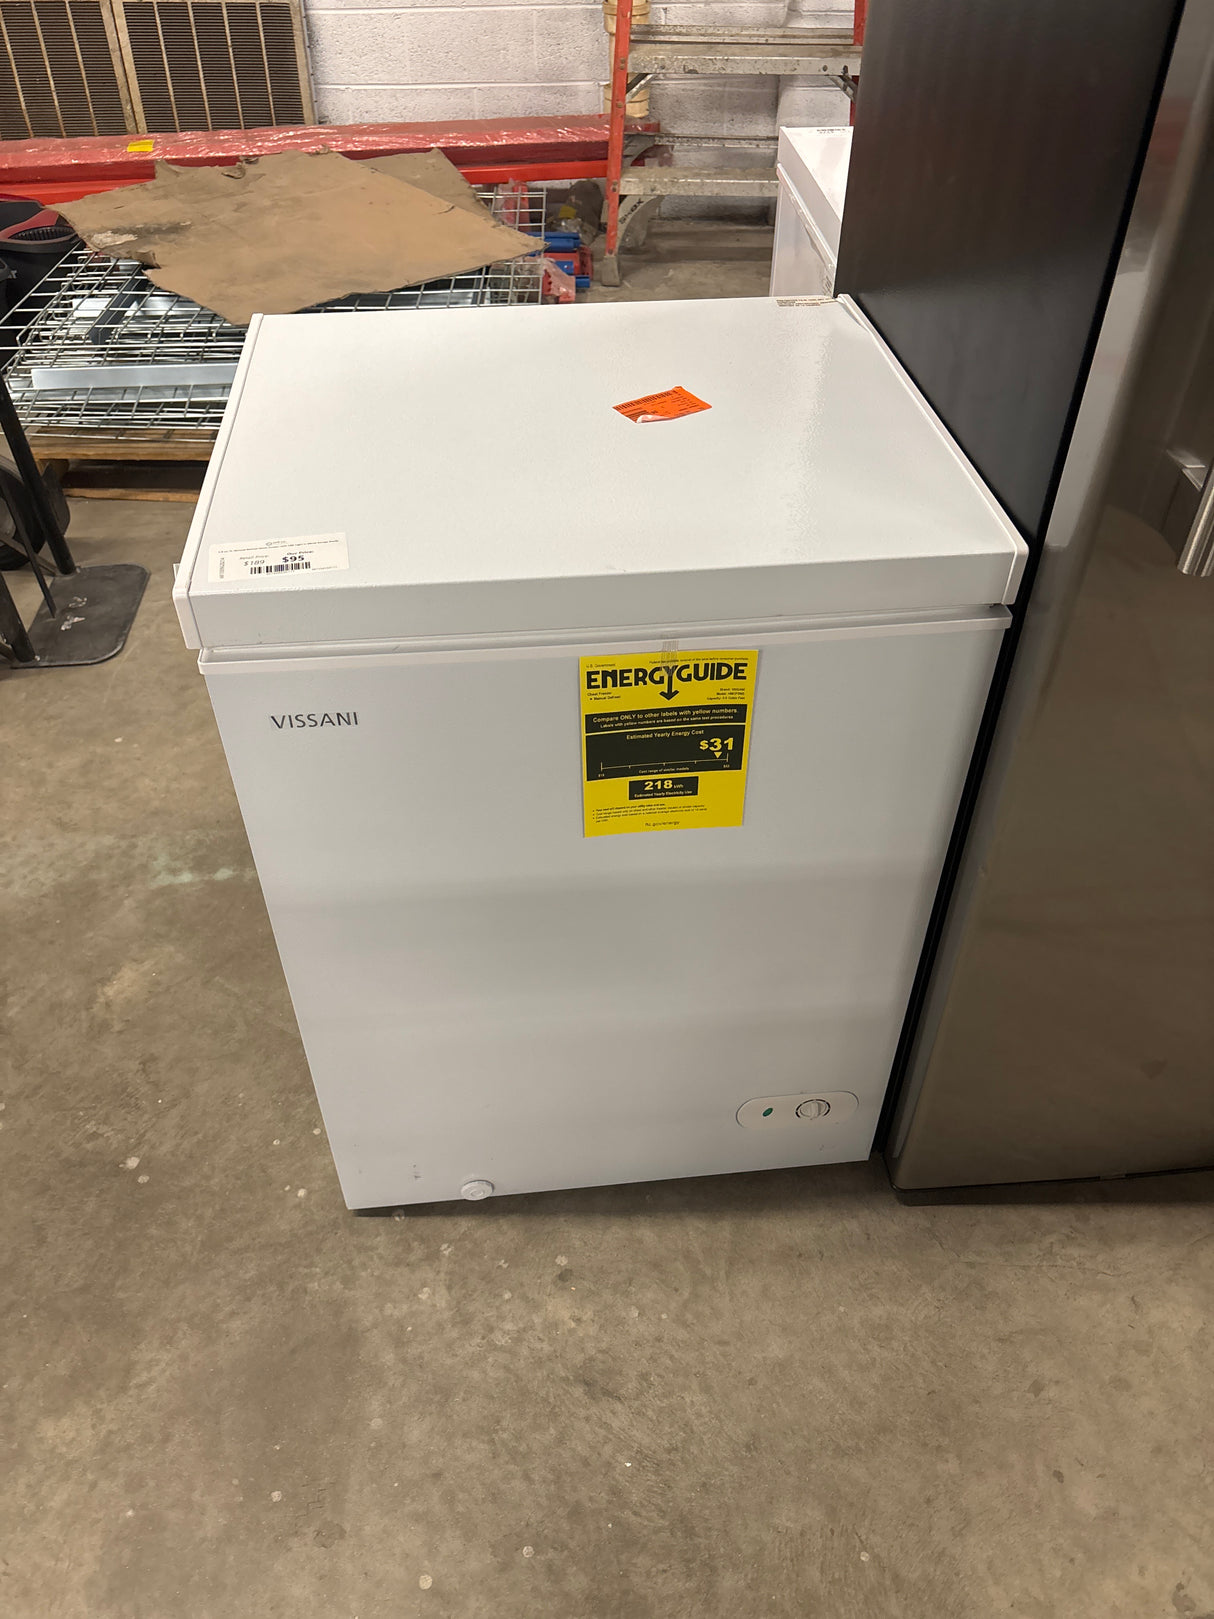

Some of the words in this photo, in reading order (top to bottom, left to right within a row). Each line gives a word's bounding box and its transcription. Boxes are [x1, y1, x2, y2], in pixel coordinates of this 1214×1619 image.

[243, 559, 265, 567] $189
[282, 554, 305, 563] $95
[586, 662, 748, 690] ENERGYGUIDE
[270, 711, 359, 729] VISSANI
[592, 716, 619, 724] Compare
[620, 713, 636, 721] ONLY
[644, 711, 660, 719] other
[660, 709, 678, 717] labels
[692, 708, 711, 716] yellow
[626, 732, 653, 740] Estimated
[654, 731, 671, 739] Yearly
[671, 729, 691, 737] Energy
[699, 737, 734, 752] $31
[644, 779, 673, 791] 218
